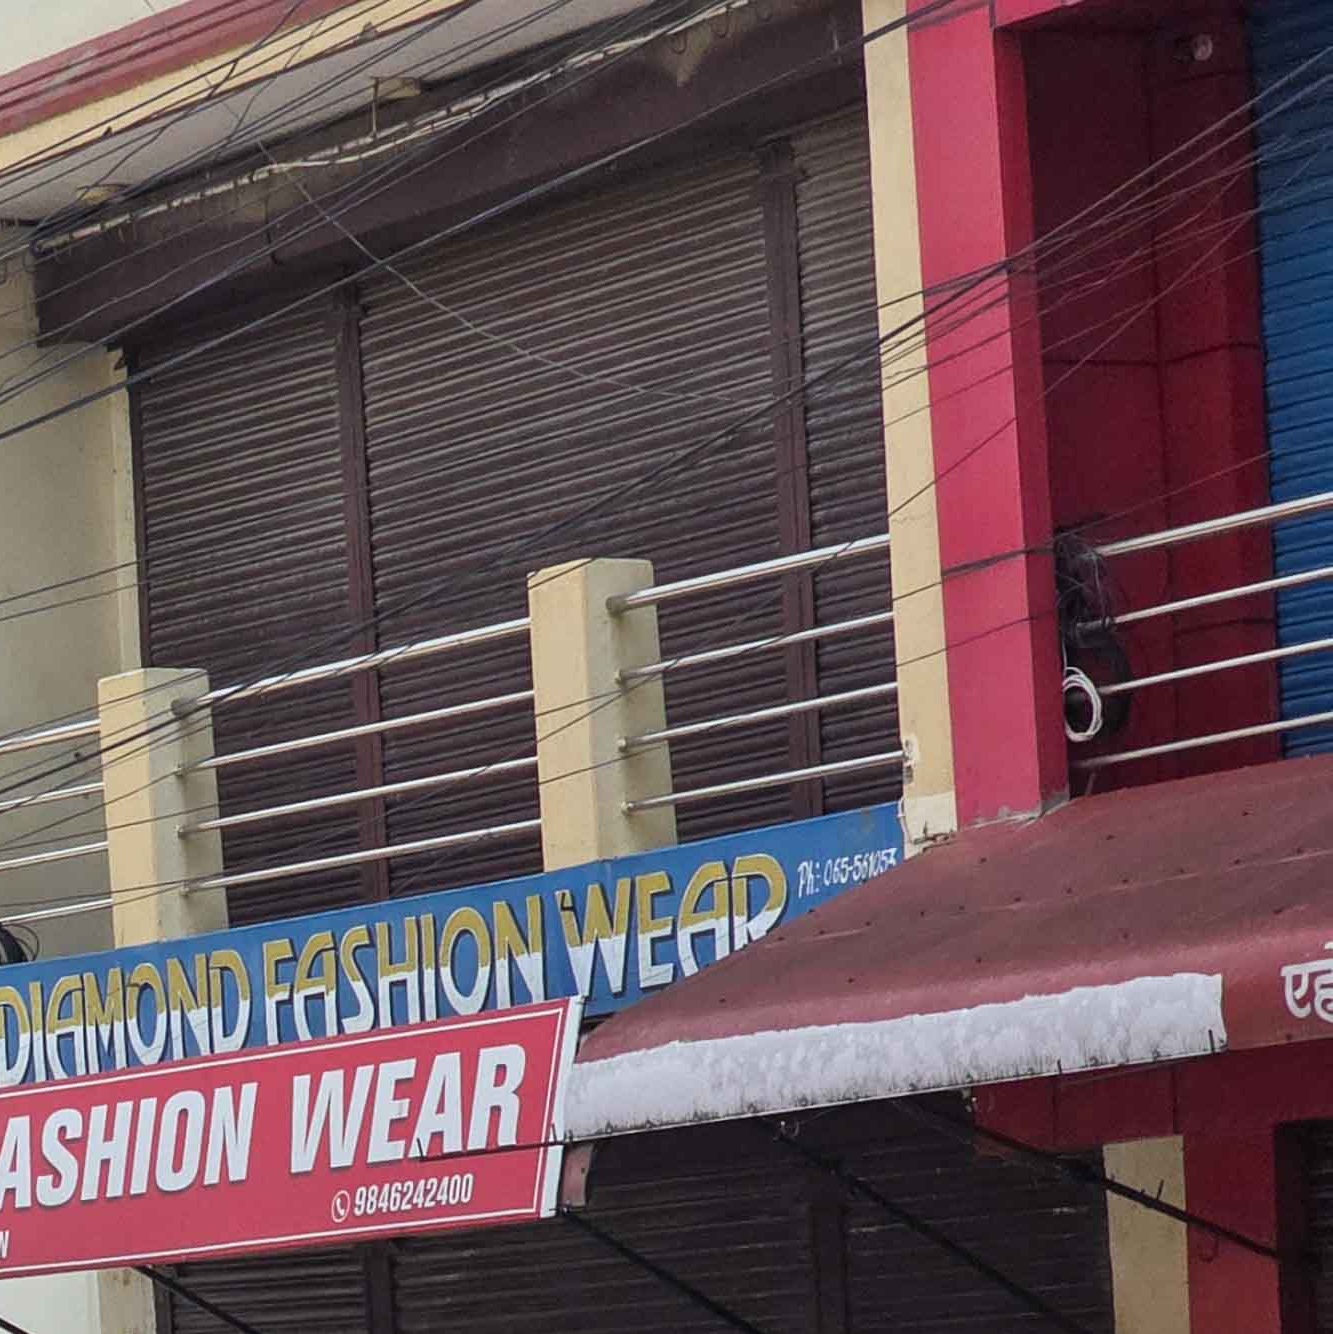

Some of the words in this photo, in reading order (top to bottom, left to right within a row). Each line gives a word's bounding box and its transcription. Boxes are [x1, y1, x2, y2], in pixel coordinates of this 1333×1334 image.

[262, 893, 543, 1046] FASHION
[558, 852, 788, 998] WEAR
[289, 1042, 527, 1174] WEAR
[353, 1172, 474, 1217] 9846242400
